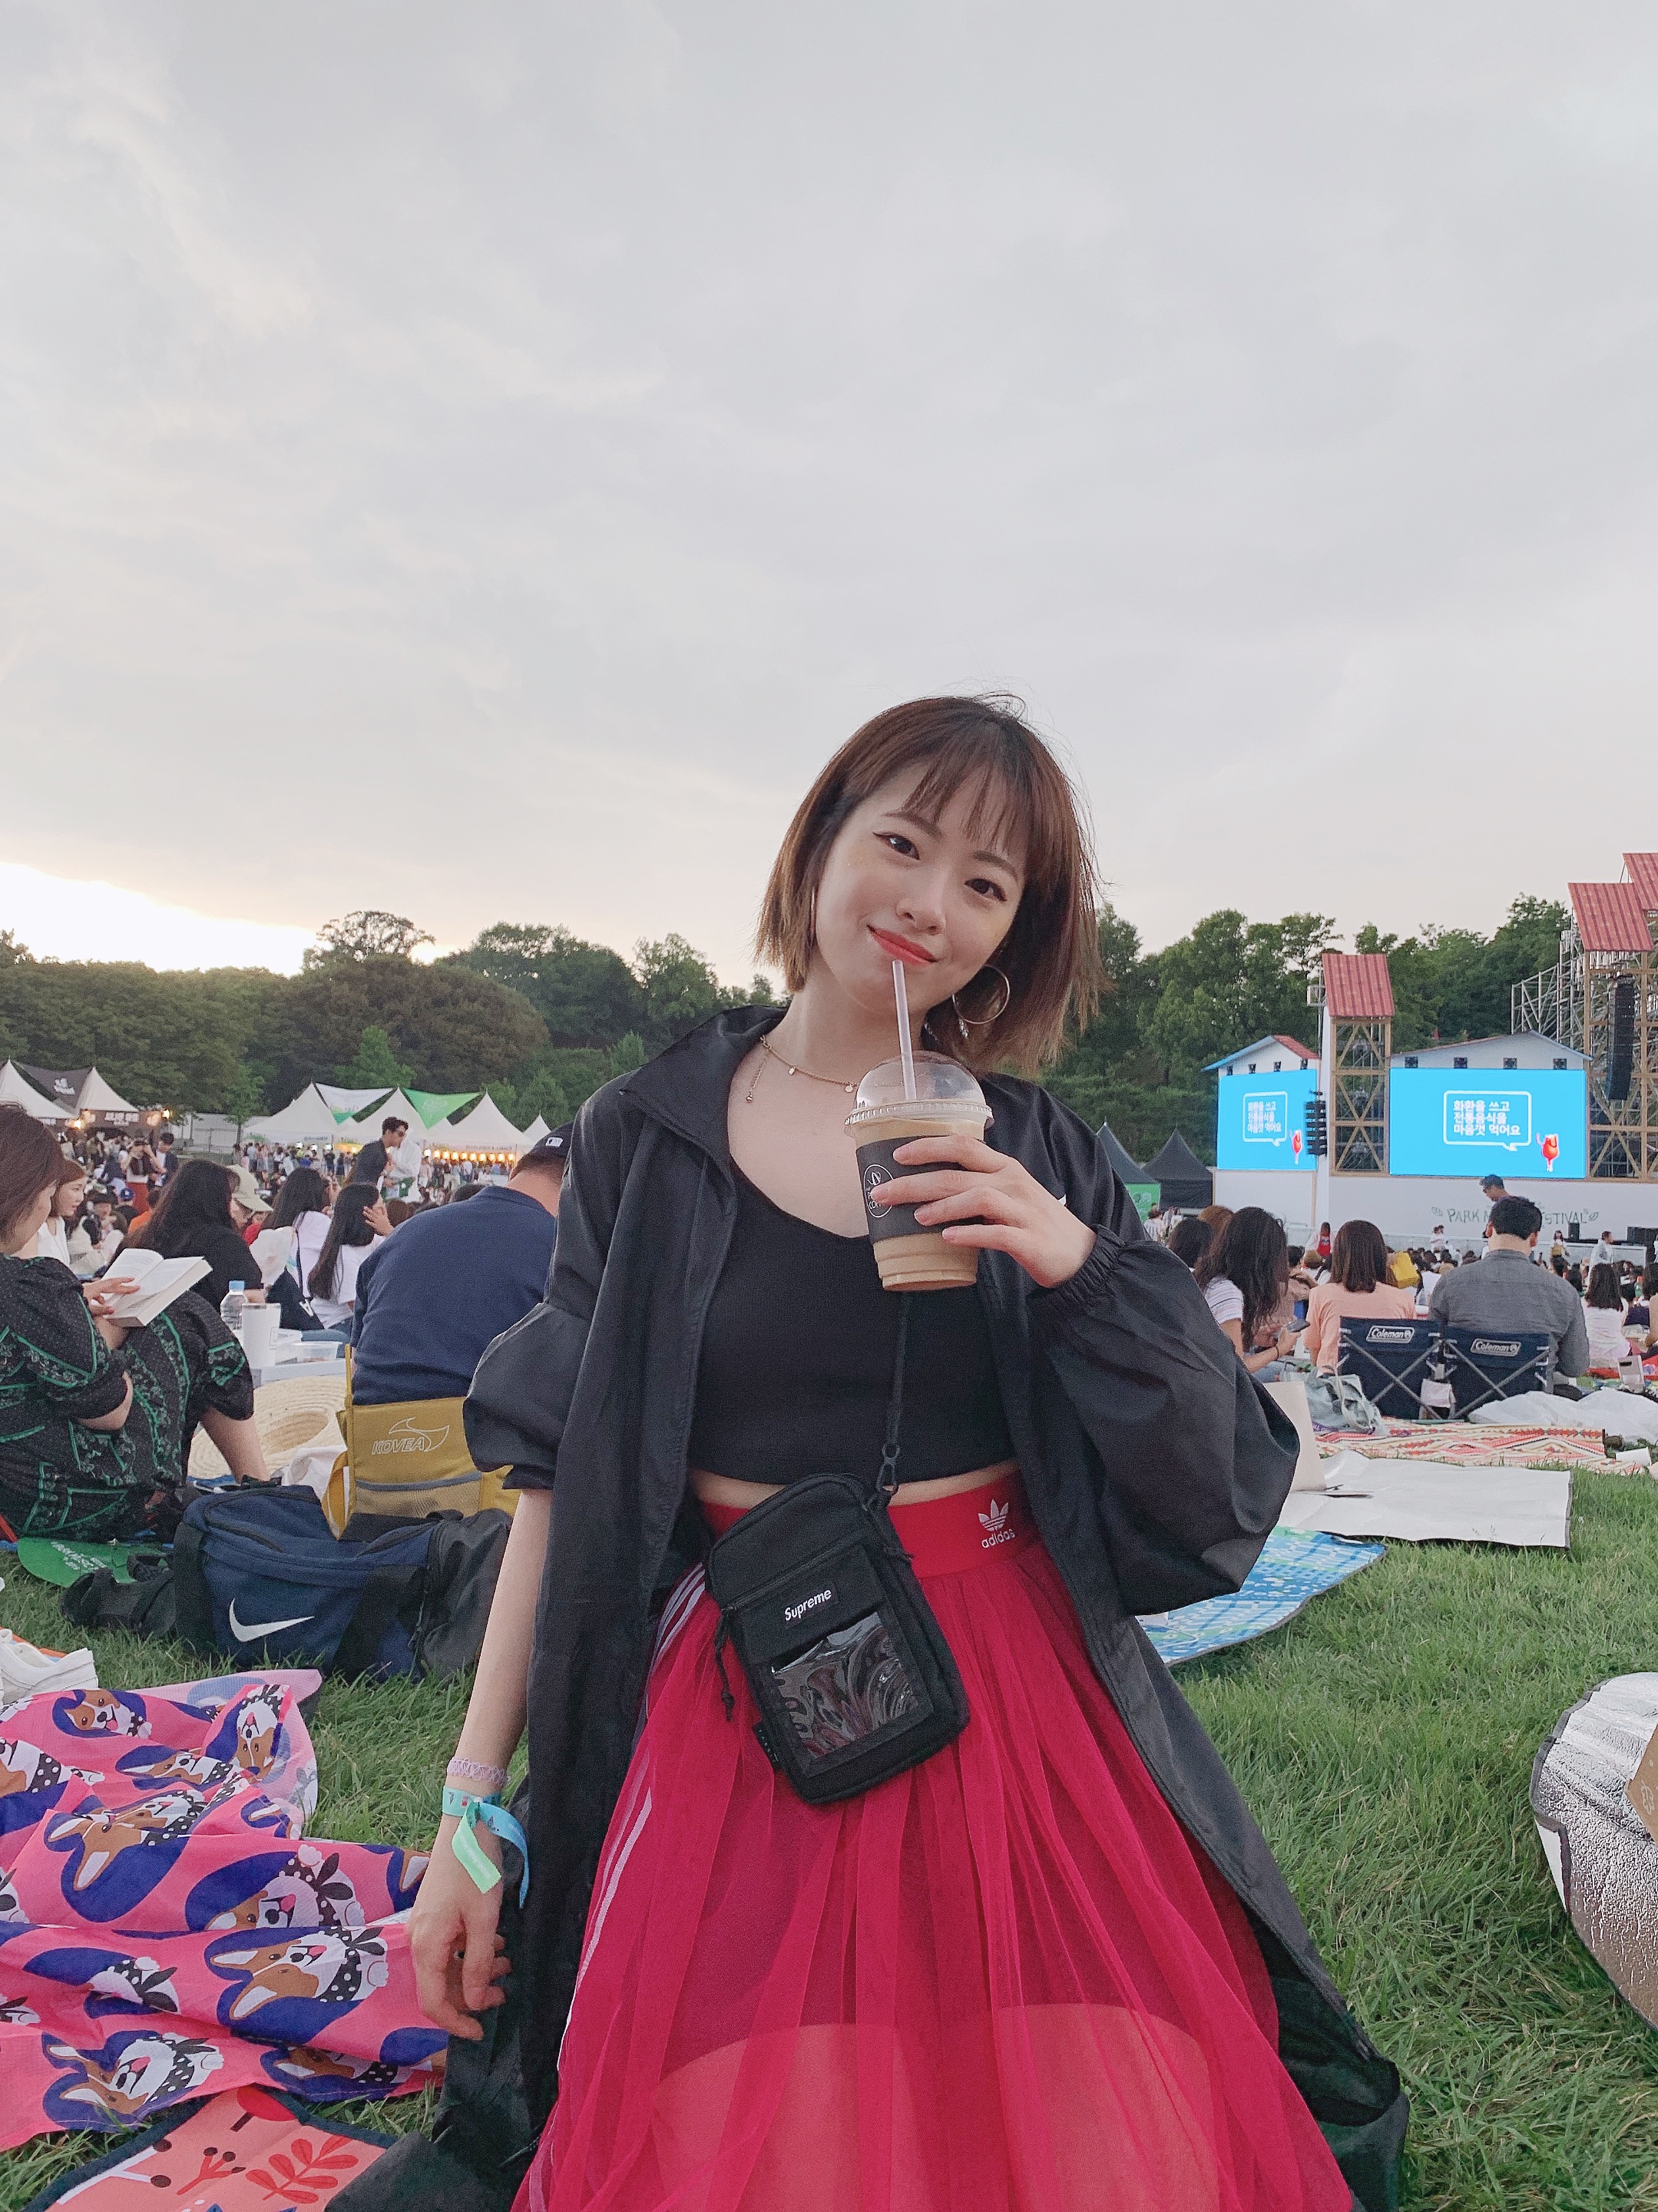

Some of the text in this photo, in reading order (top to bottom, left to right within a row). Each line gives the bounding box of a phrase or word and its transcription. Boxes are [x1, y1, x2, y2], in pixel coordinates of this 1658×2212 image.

[1488, 1101, 1511, 1111] 쓰고
[1488, 1124, 1521, 1136] 먹어요
[1447, 1208, 1480, 1223] PARK
[1372, 1328, 1405, 1339] Coleman
[1475, 1341, 1510, 1352] Coleman
[372, 1437, 425, 1455] KOVEA
[981, 1528, 1015, 1548] adidas
[784, 1589, 832, 1621] Supreme
